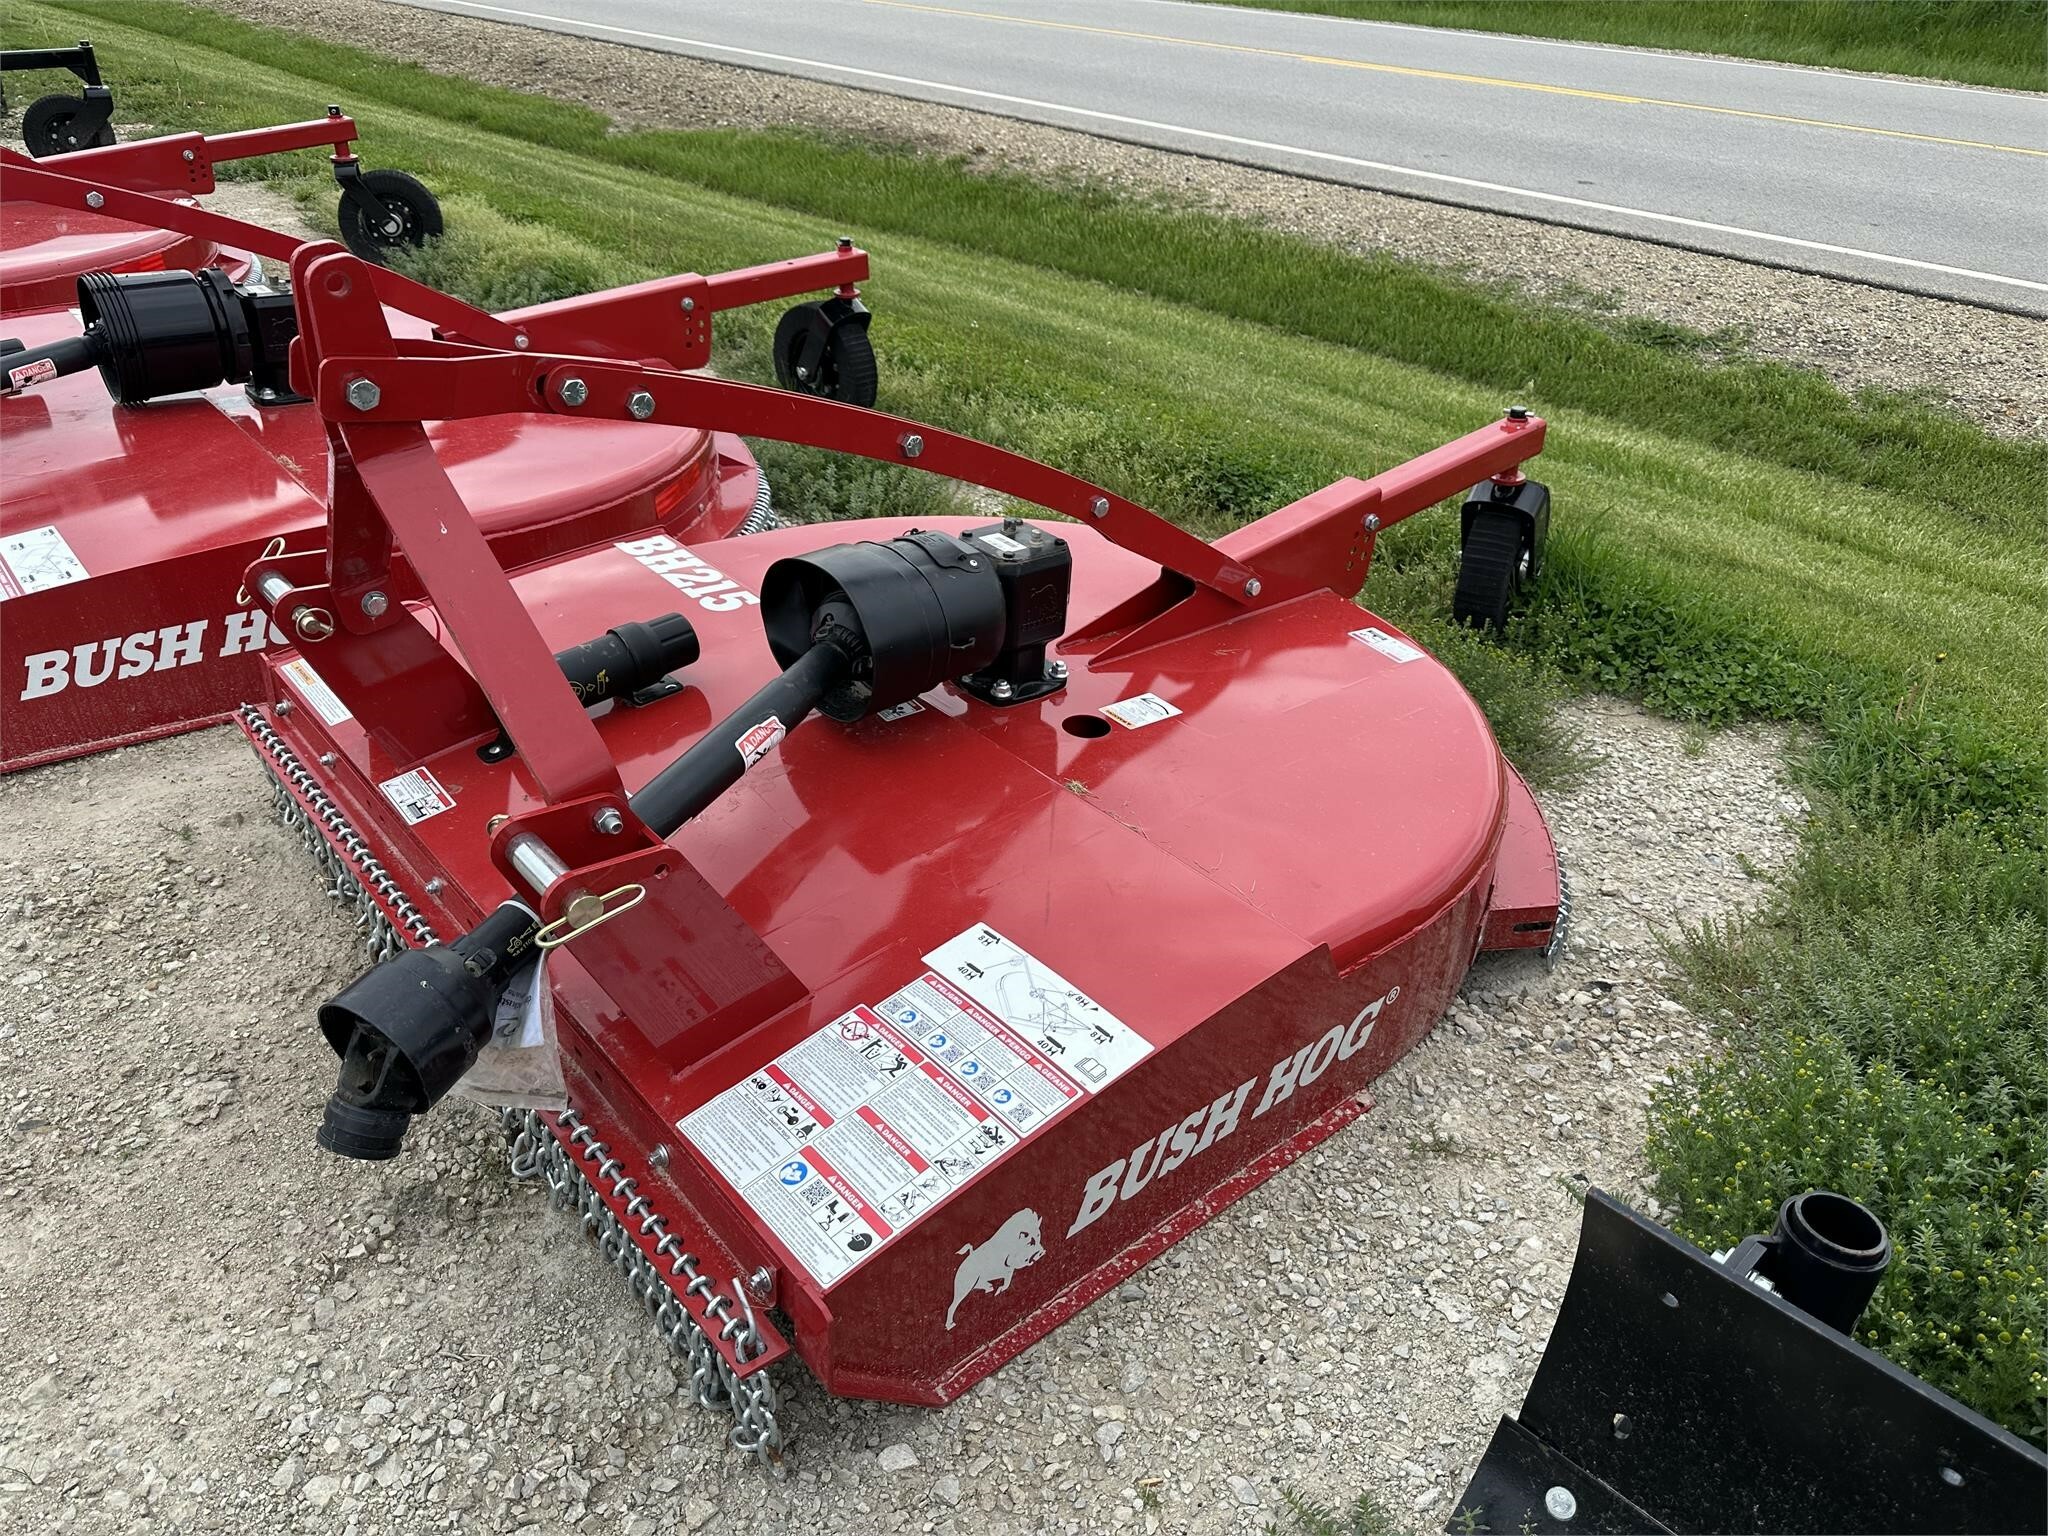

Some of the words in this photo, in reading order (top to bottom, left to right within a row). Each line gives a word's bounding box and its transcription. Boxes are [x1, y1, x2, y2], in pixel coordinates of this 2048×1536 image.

[613, 534, 761, 612] BH215
[20, 619, 209, 701] BUSH
[934, 980, 963, 1006] PELIGRO
[971, 1010, 999, 1035] DANGER
[879, 1026, 906, 1050] DANGER
[1004, 1036, 1032, 1061] PERIGO
[942, 1079, 972, 1107] DANGER
[1041, 1068, 1070, 1094] GEFAHR
[788, 1086, 815, 1112] DANGER
[1065, 1075, 1258, 1240] BUSH
[1250, 995, 1387, 1121] HOG
[882, 1128, 911, 1157] DANGER
[834, 1180, 864, 1211] DANGER
